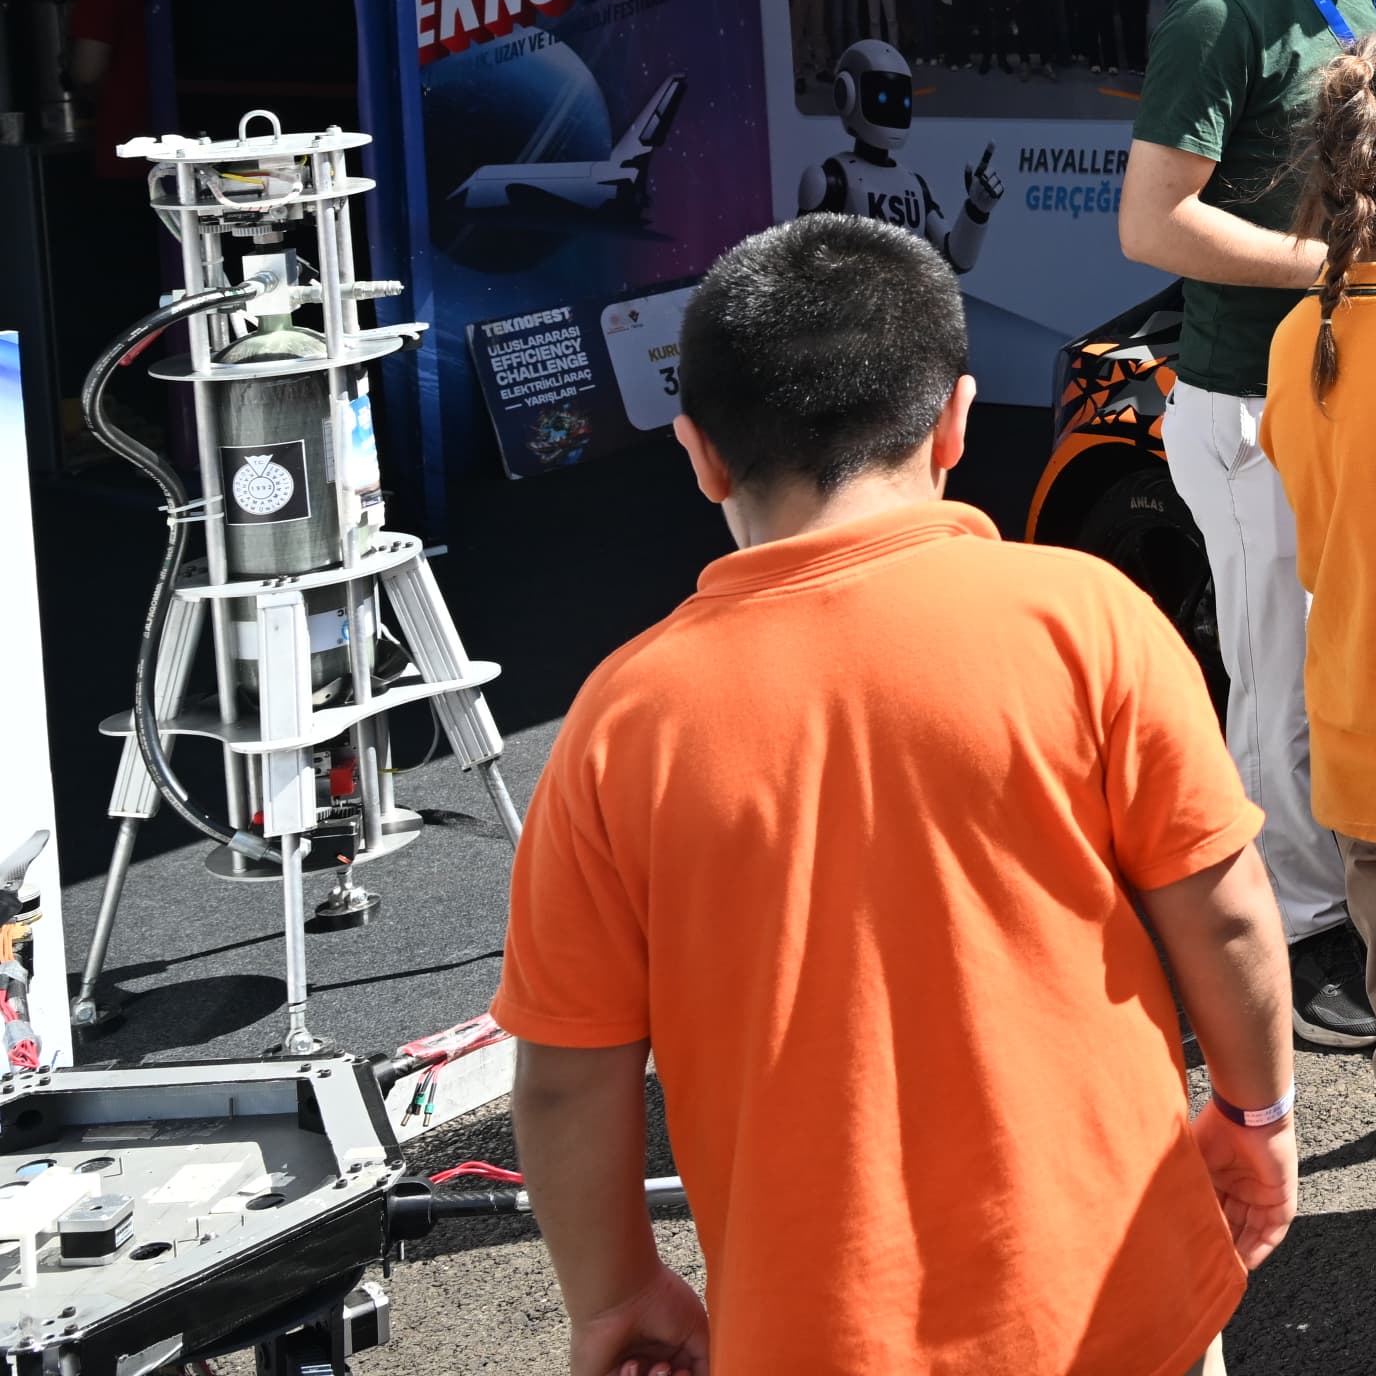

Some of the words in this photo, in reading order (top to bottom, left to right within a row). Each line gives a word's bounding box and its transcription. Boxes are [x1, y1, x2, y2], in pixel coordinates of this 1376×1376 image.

[867, 190, 921, 230] KSÜ
[481, 306, 573, 338] TEKNOFEST
[487, 325, 581, 357] ULUSLARARASI
[490, 337, 583, 372] EFFICIENCY
[495, 352, 590, 387] CHALLENGE
[499, 375, 563, 401] ELEKTRİKLİ
[563, 368, 593, 387] ARAÇ
[659, 366, 681, 397] 3
[523, 385, 577, 409] YARIŞLARI
